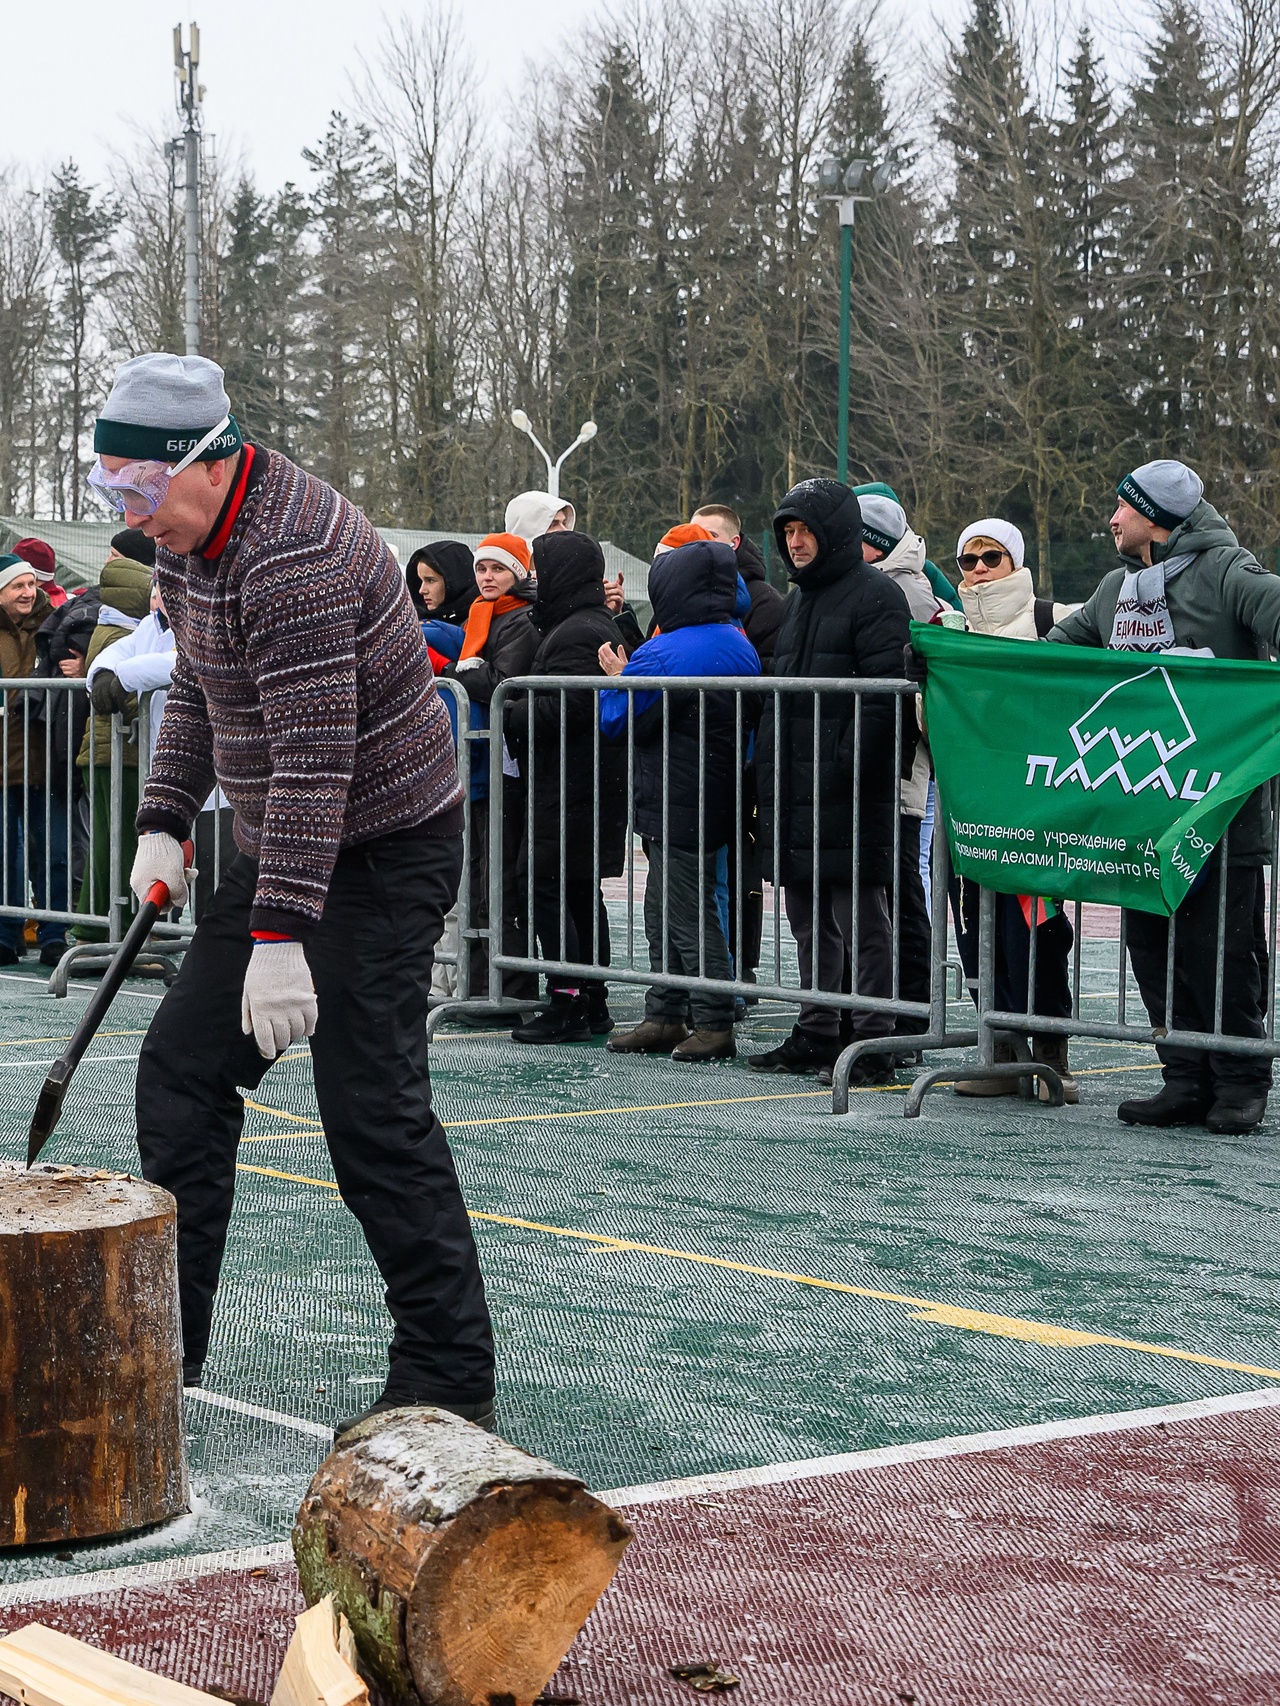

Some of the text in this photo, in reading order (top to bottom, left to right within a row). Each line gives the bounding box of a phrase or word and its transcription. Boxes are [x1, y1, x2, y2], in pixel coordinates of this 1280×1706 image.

[166, 433, 237, 452] БЕЛРУСЬ
[1122, 481, 1156, 518] БЕЛАРУСЬ
[861, 528, 891, 547] ЛАРУСЬ
[1116, 619, 1167, 639] ЕДИНЫЕ
[949, 813, 1035, 842] ударственное
[1043, 830, 1127, 851] учреждение
[955, 841, 998, 861] равления
[1000, 850, 1054, 867] делами
[1057, 852, 1141, 876] Президента
